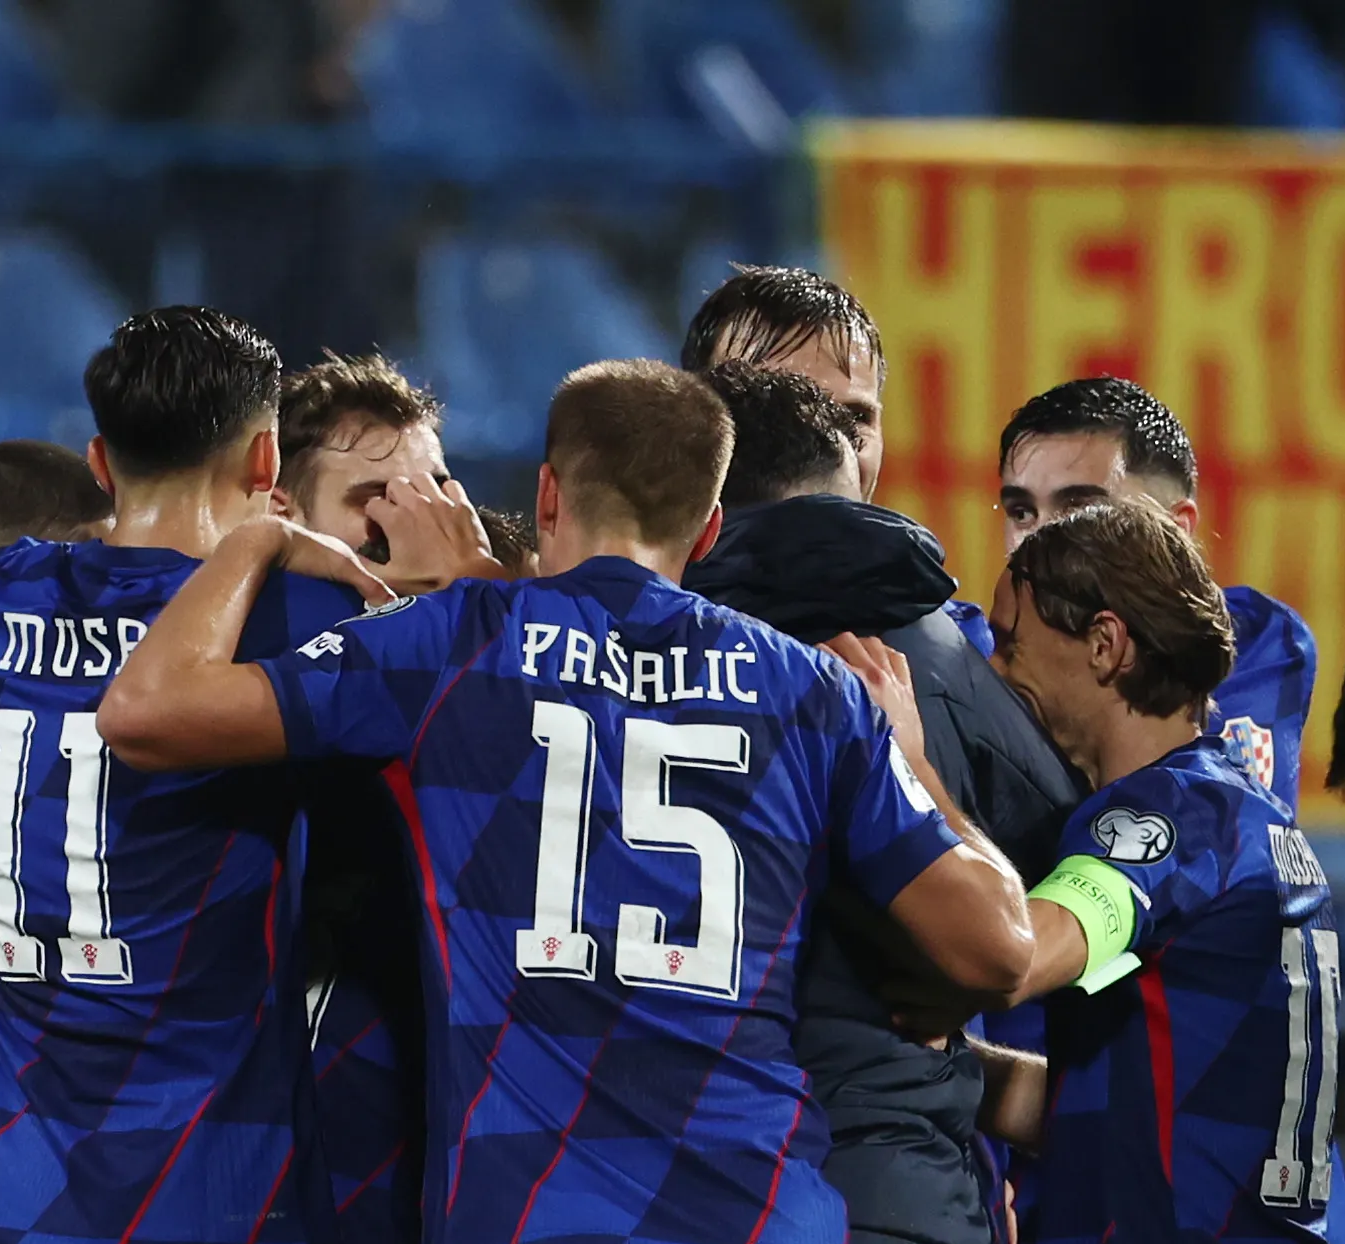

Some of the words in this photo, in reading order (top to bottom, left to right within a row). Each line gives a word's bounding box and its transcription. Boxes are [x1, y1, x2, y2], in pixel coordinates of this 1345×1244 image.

[522, 622, 757, 703] PAŠALIĆ
[516, 701, 749, 1000] 15
[1068, 876, 1119, 936] RESPECT
